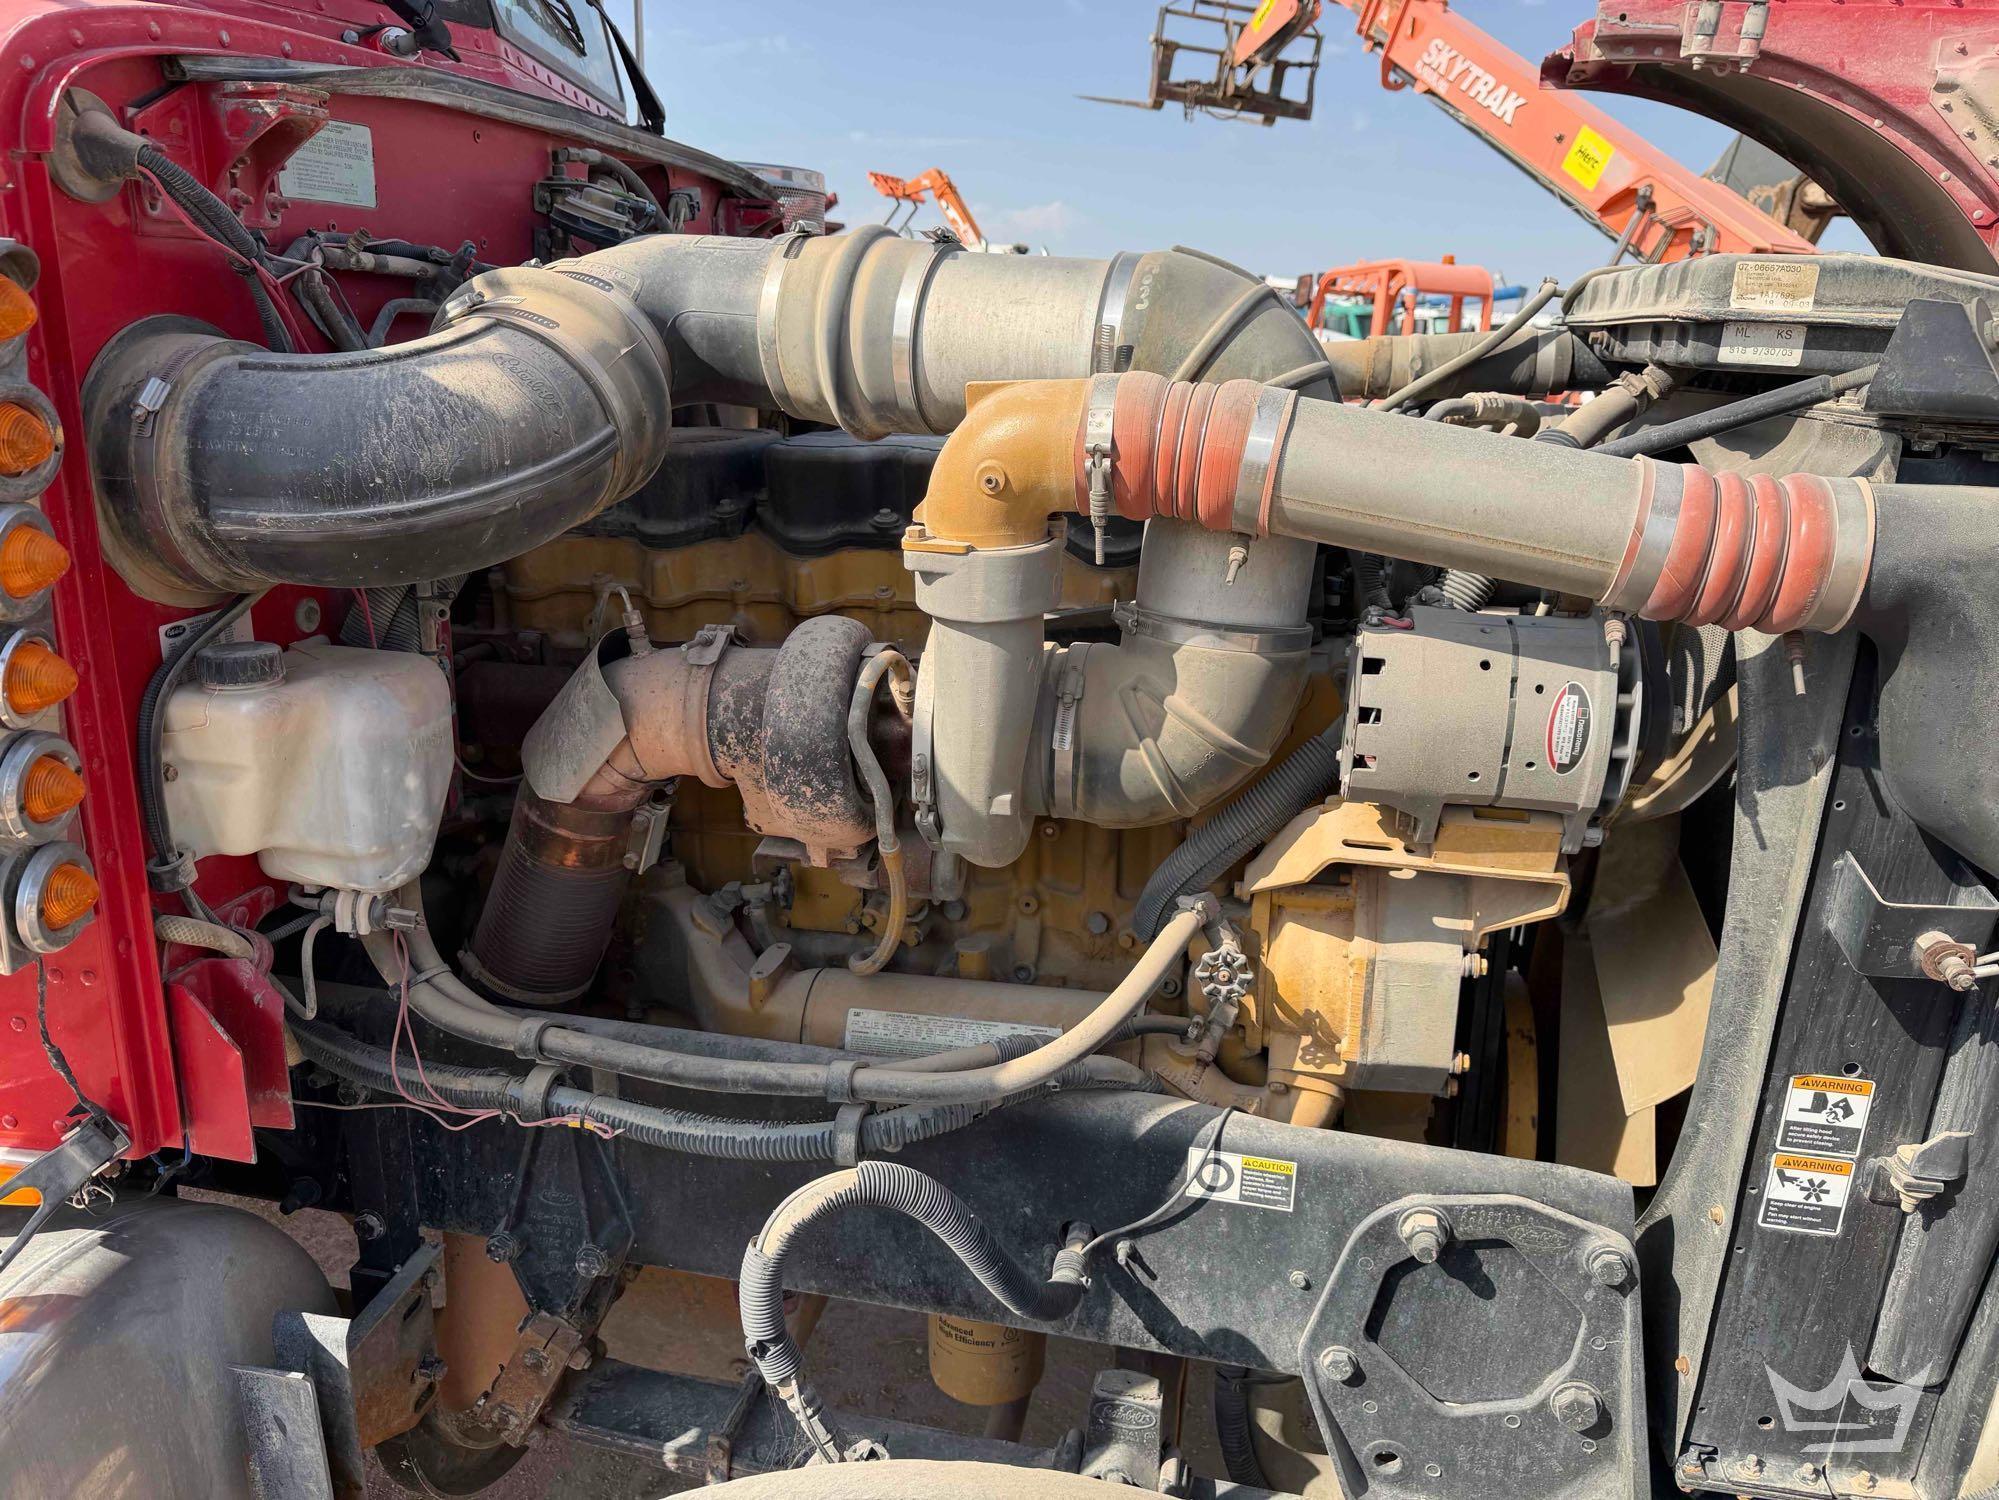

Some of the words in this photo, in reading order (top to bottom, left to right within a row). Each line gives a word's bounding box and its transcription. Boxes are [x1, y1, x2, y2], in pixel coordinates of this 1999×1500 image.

[1421, 38, 1528, 127] SKYTRAK
[1776, 329, 1793, 340] KS
[1752, 347, 1793, 357] 9/30/03
[1576, 719, 1585, 738] Delco
[1572, 737, 1583, 756] Remy
[1811, 1080, 1863, 1093] WARNING
[1252, 1160, 1293, 1173] CAUTION
[1791, 1159, 1844, 1172] WARNING
[938, 1315, 974, 1337] Advanced
[954, 1333, 996, 1348] Efficiency
